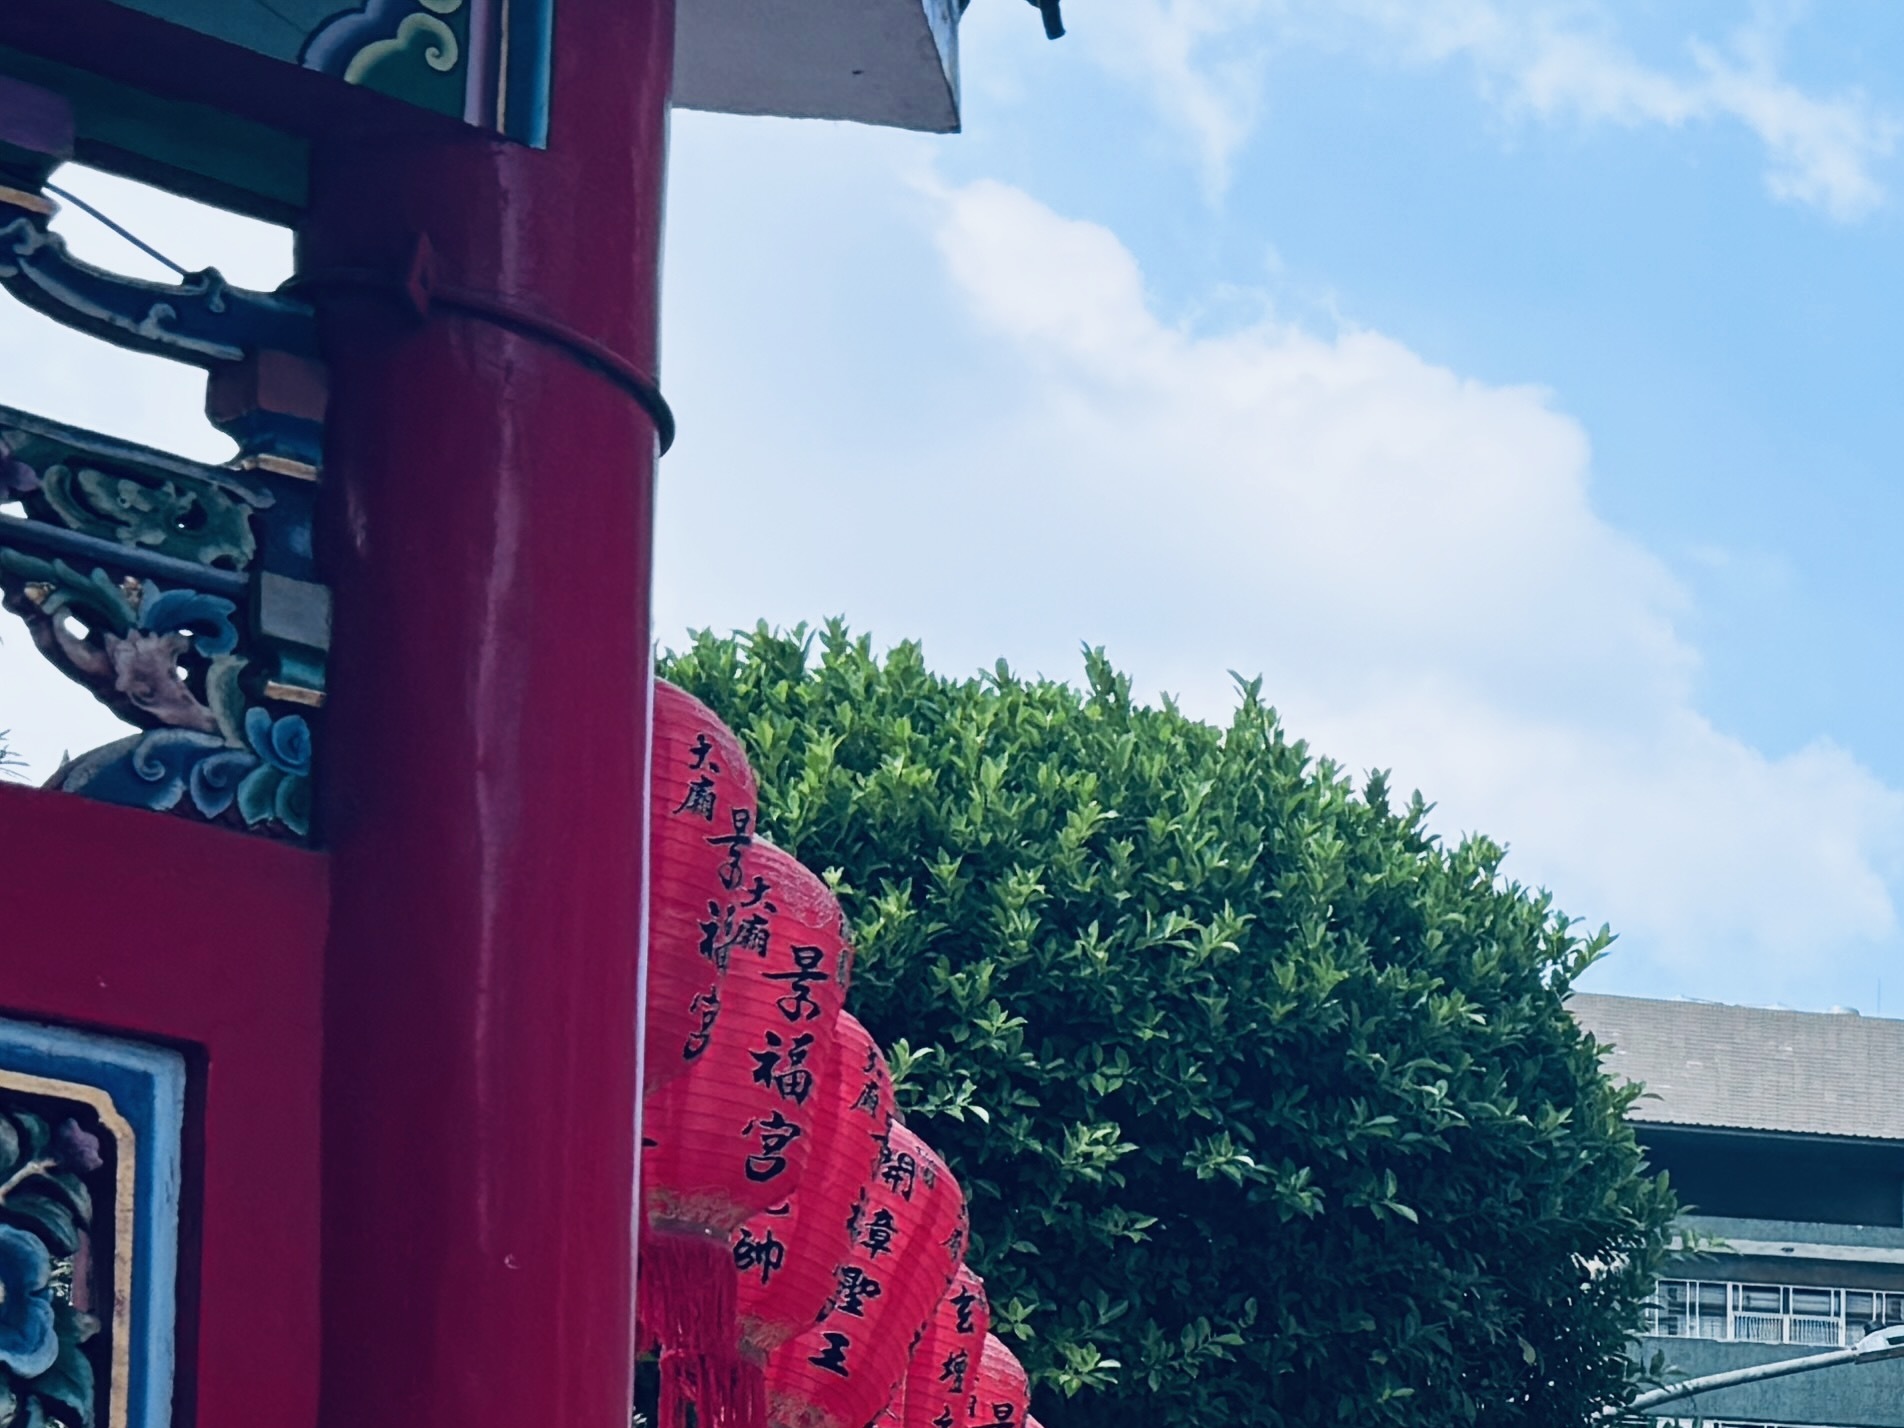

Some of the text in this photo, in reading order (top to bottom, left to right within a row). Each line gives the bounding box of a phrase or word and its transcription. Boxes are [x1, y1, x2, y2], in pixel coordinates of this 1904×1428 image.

[673, 733, 722, 822] 大廟
[730, 875, 777, 959] 大廟
[743, 944, 831, 1183] 景福宮
